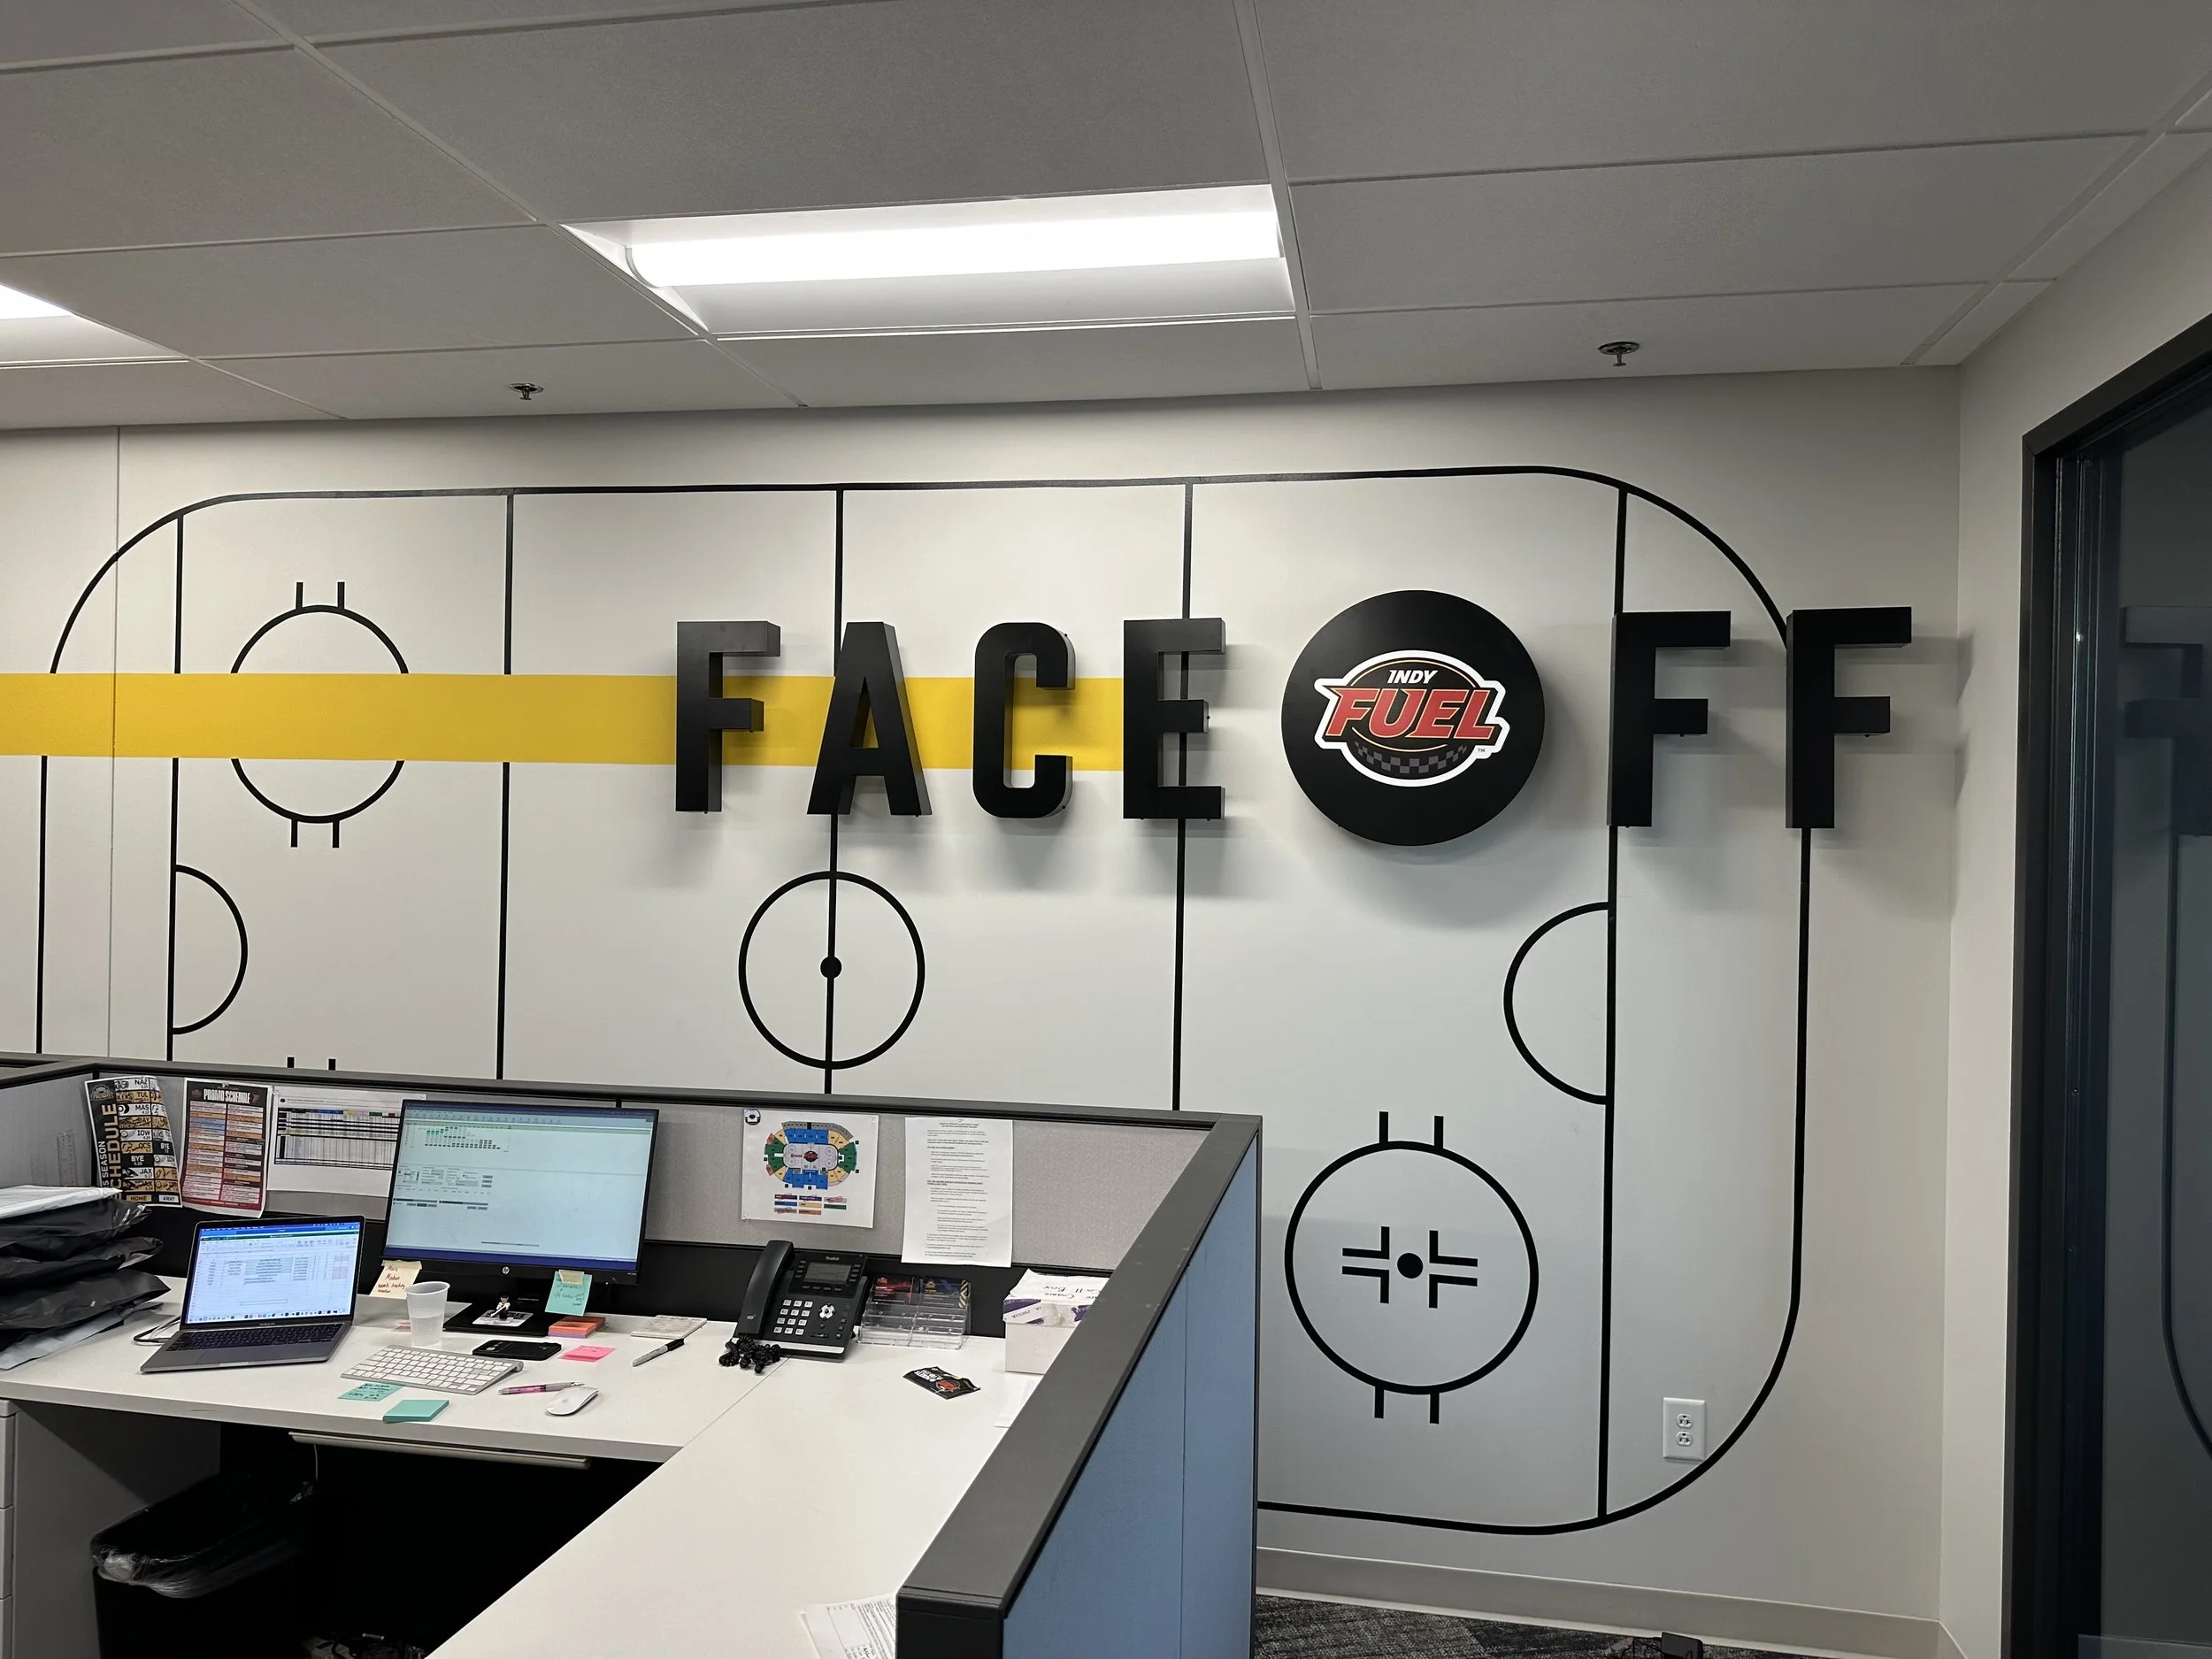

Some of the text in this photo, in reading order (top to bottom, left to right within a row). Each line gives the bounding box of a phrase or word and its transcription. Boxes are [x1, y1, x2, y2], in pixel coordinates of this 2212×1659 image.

[1386, 669, 1438, 684] INDY
[675, 618, 1225, 820] FACE
[1325, 687, 1495, 740] FUEL
[203, 1088, 251, 1104] PROMO SCHEDULE
[97, 1141, 110, 1179] SEASON
